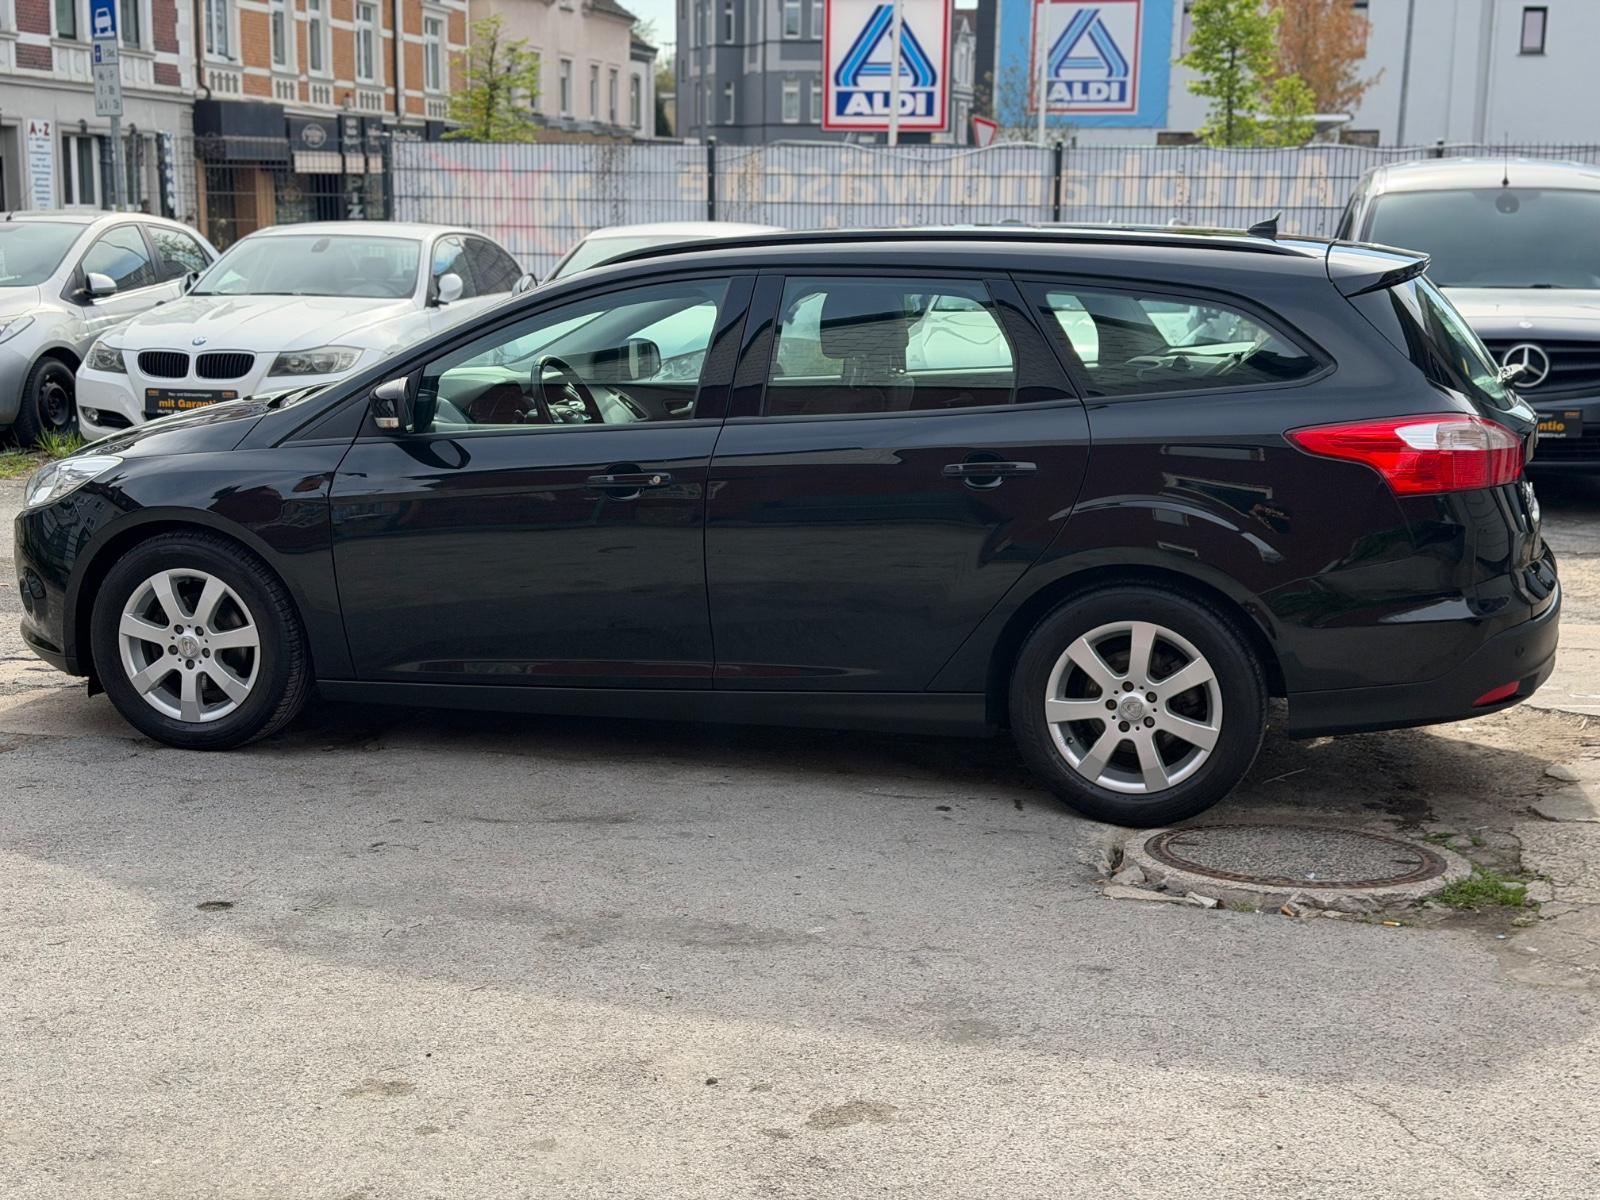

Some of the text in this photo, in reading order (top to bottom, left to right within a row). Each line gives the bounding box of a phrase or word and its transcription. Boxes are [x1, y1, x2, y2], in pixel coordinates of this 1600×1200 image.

[1047, 81, 1119, 102] ALDI
[843, 92, 927, 116] ALDI
[159, 399, 175, 408] mit
